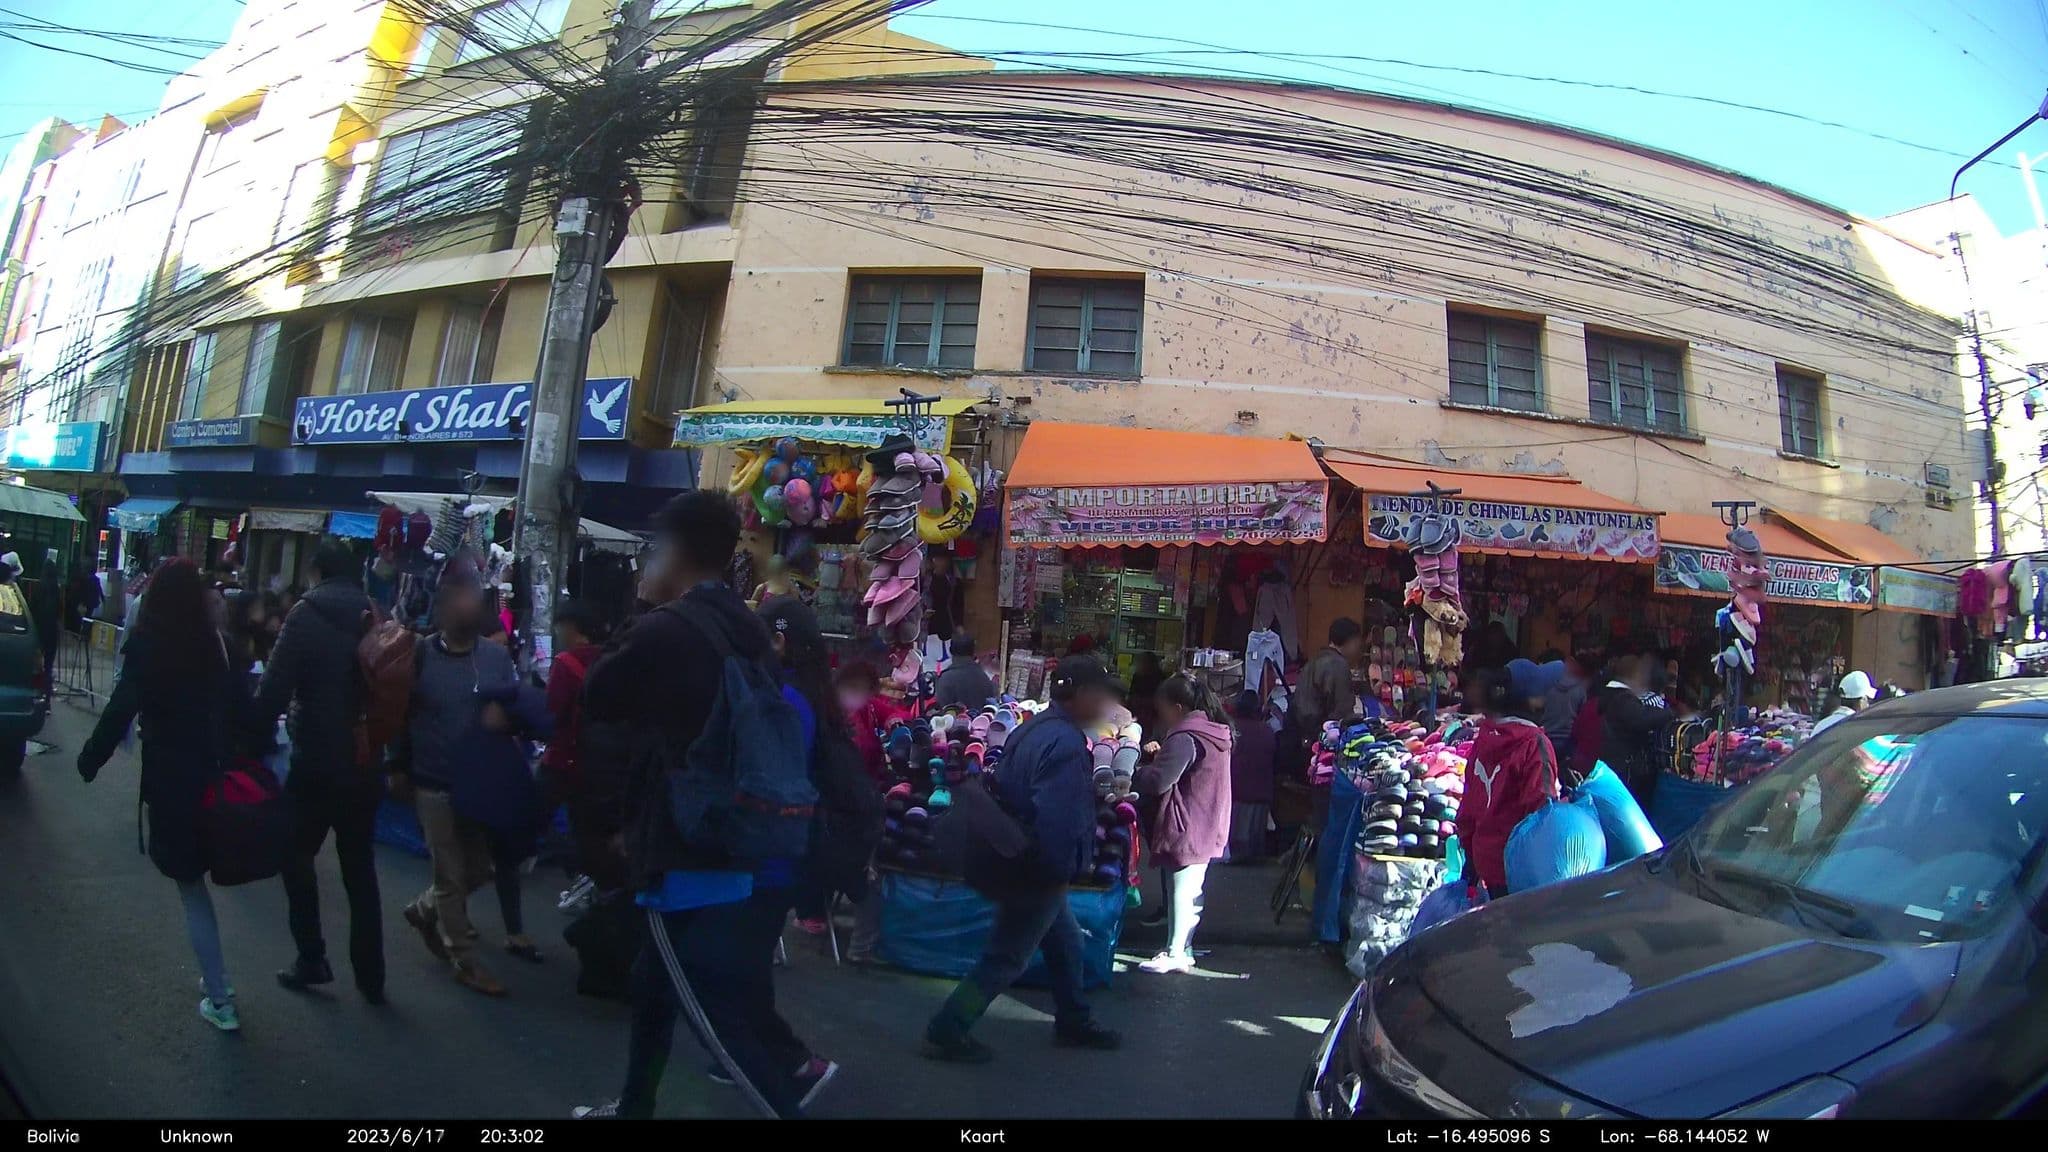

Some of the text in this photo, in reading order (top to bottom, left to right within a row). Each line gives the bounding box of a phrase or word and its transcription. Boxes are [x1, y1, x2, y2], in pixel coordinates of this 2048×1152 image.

[315, 391, 420, 435] Hotel
[197, 419, 242, 437] Comercial
[1057, 482, 1279, 508] IMPORTADORA
[1059, 519, 1182, 533] VICTOR
[1441, 498, 1464, 516] DE
[1468, 502, 1552, 523] CHINELAS
[1555, 509, 1655, 531] PANTUNFLAS
[1774, 562, 1840, 584] CHINELAS
